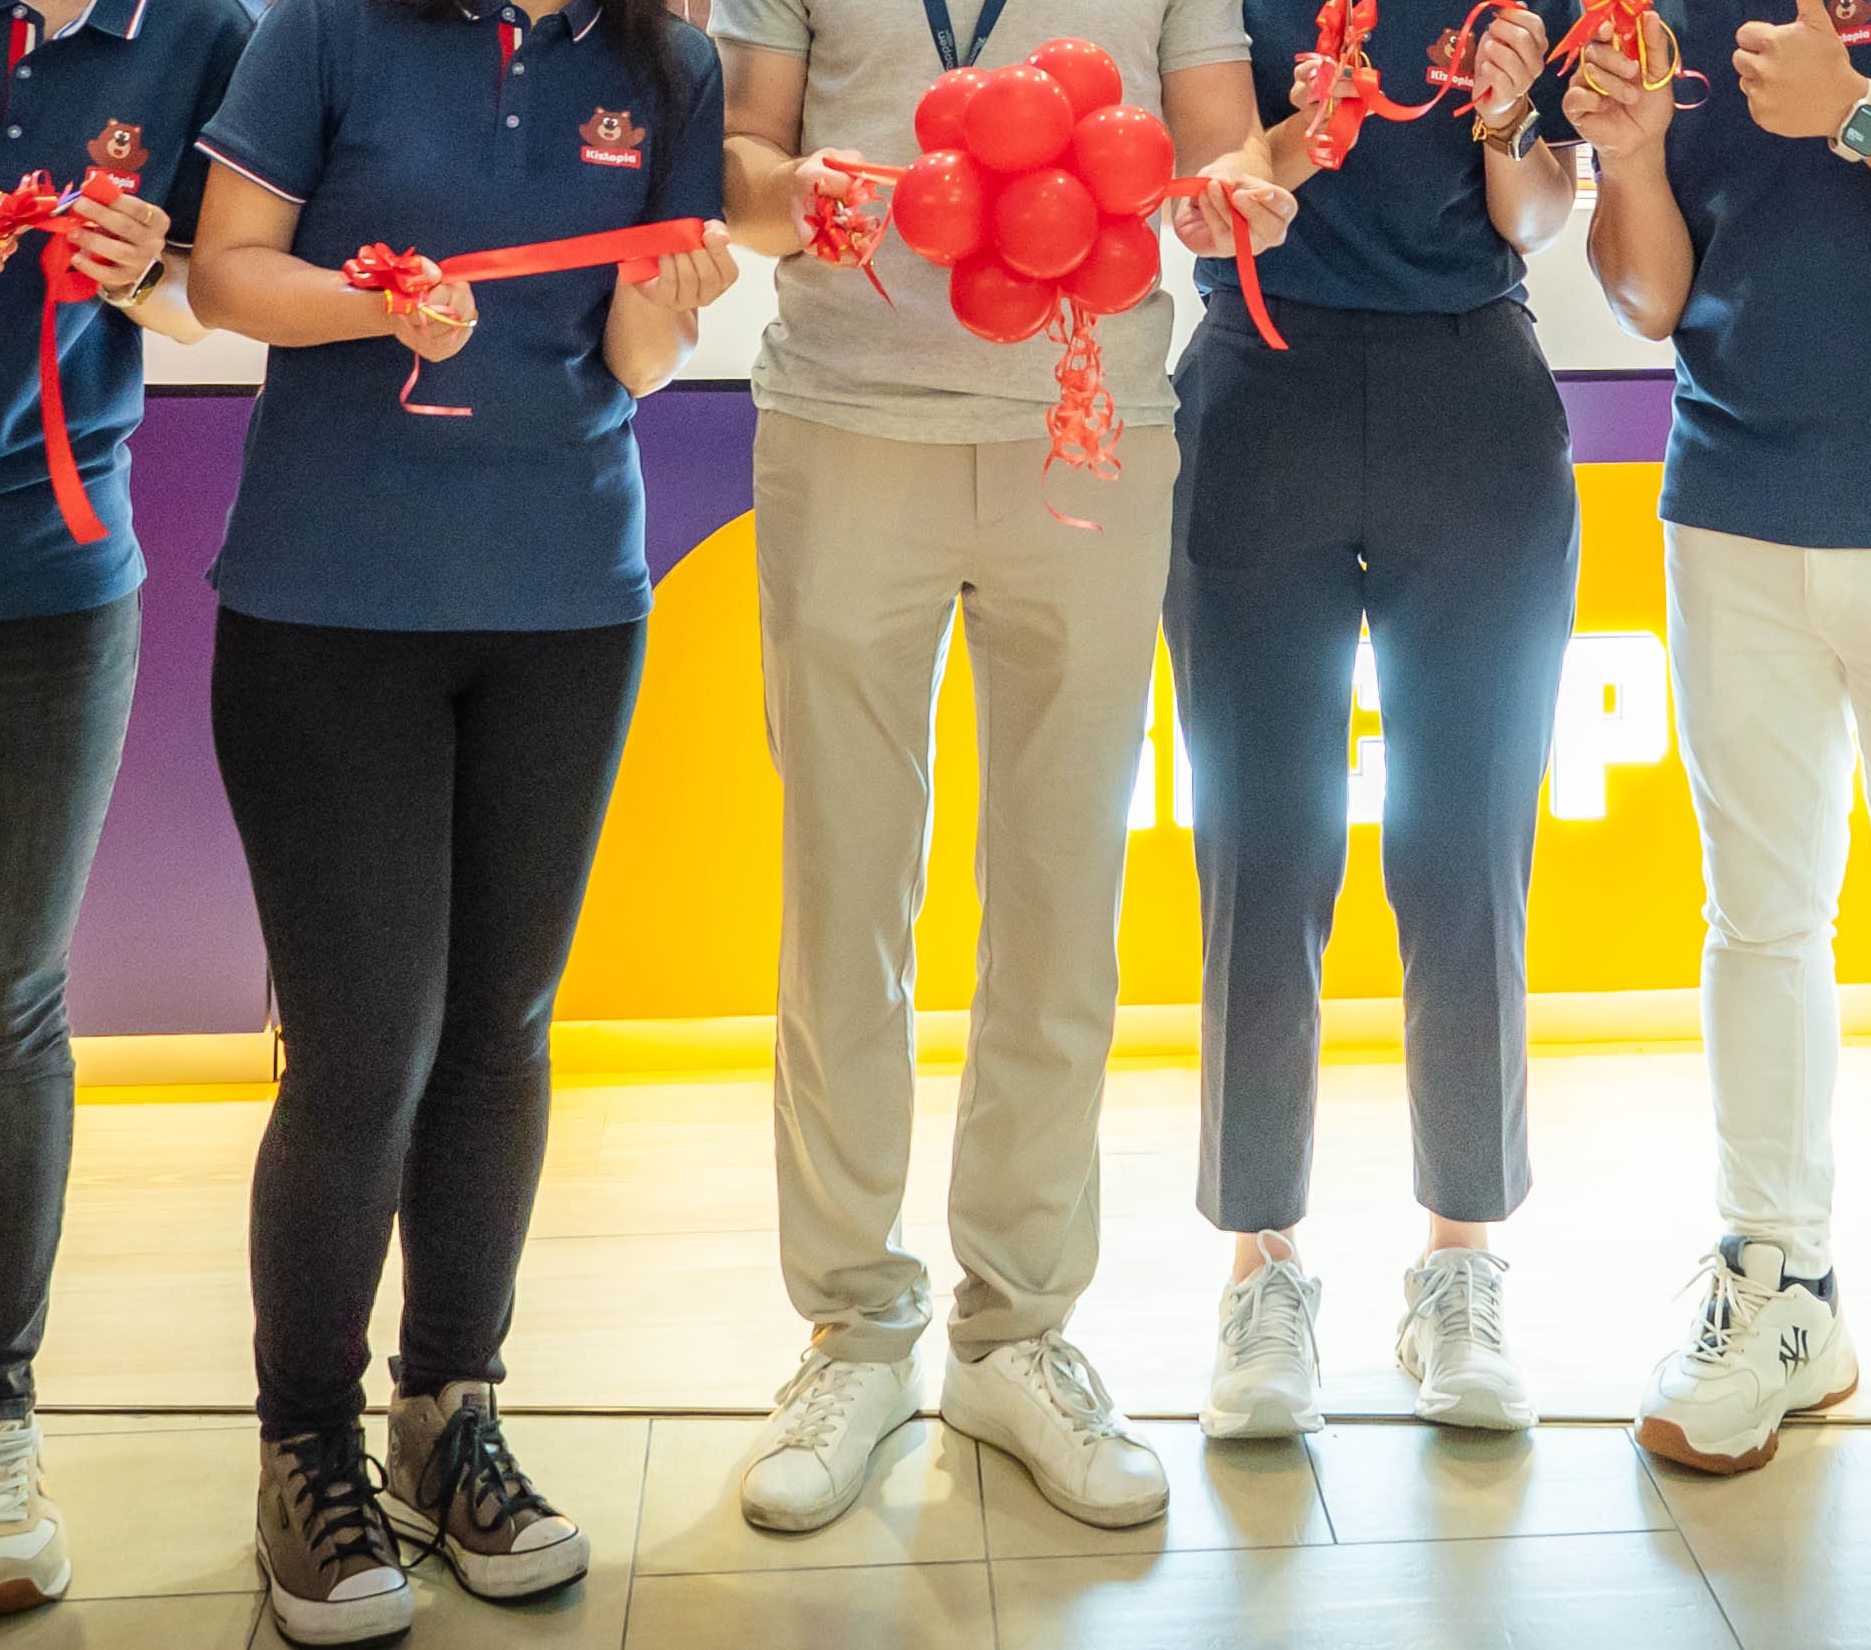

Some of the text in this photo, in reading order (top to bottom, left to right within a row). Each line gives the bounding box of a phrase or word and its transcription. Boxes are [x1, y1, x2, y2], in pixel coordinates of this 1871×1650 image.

[1840, 30, 1870, 42] topia
[937, 30, 954, 70] oppen
[1430, 70, 1475, 87] Kizopia
[585, 149, 637, 164] Kiztopia
